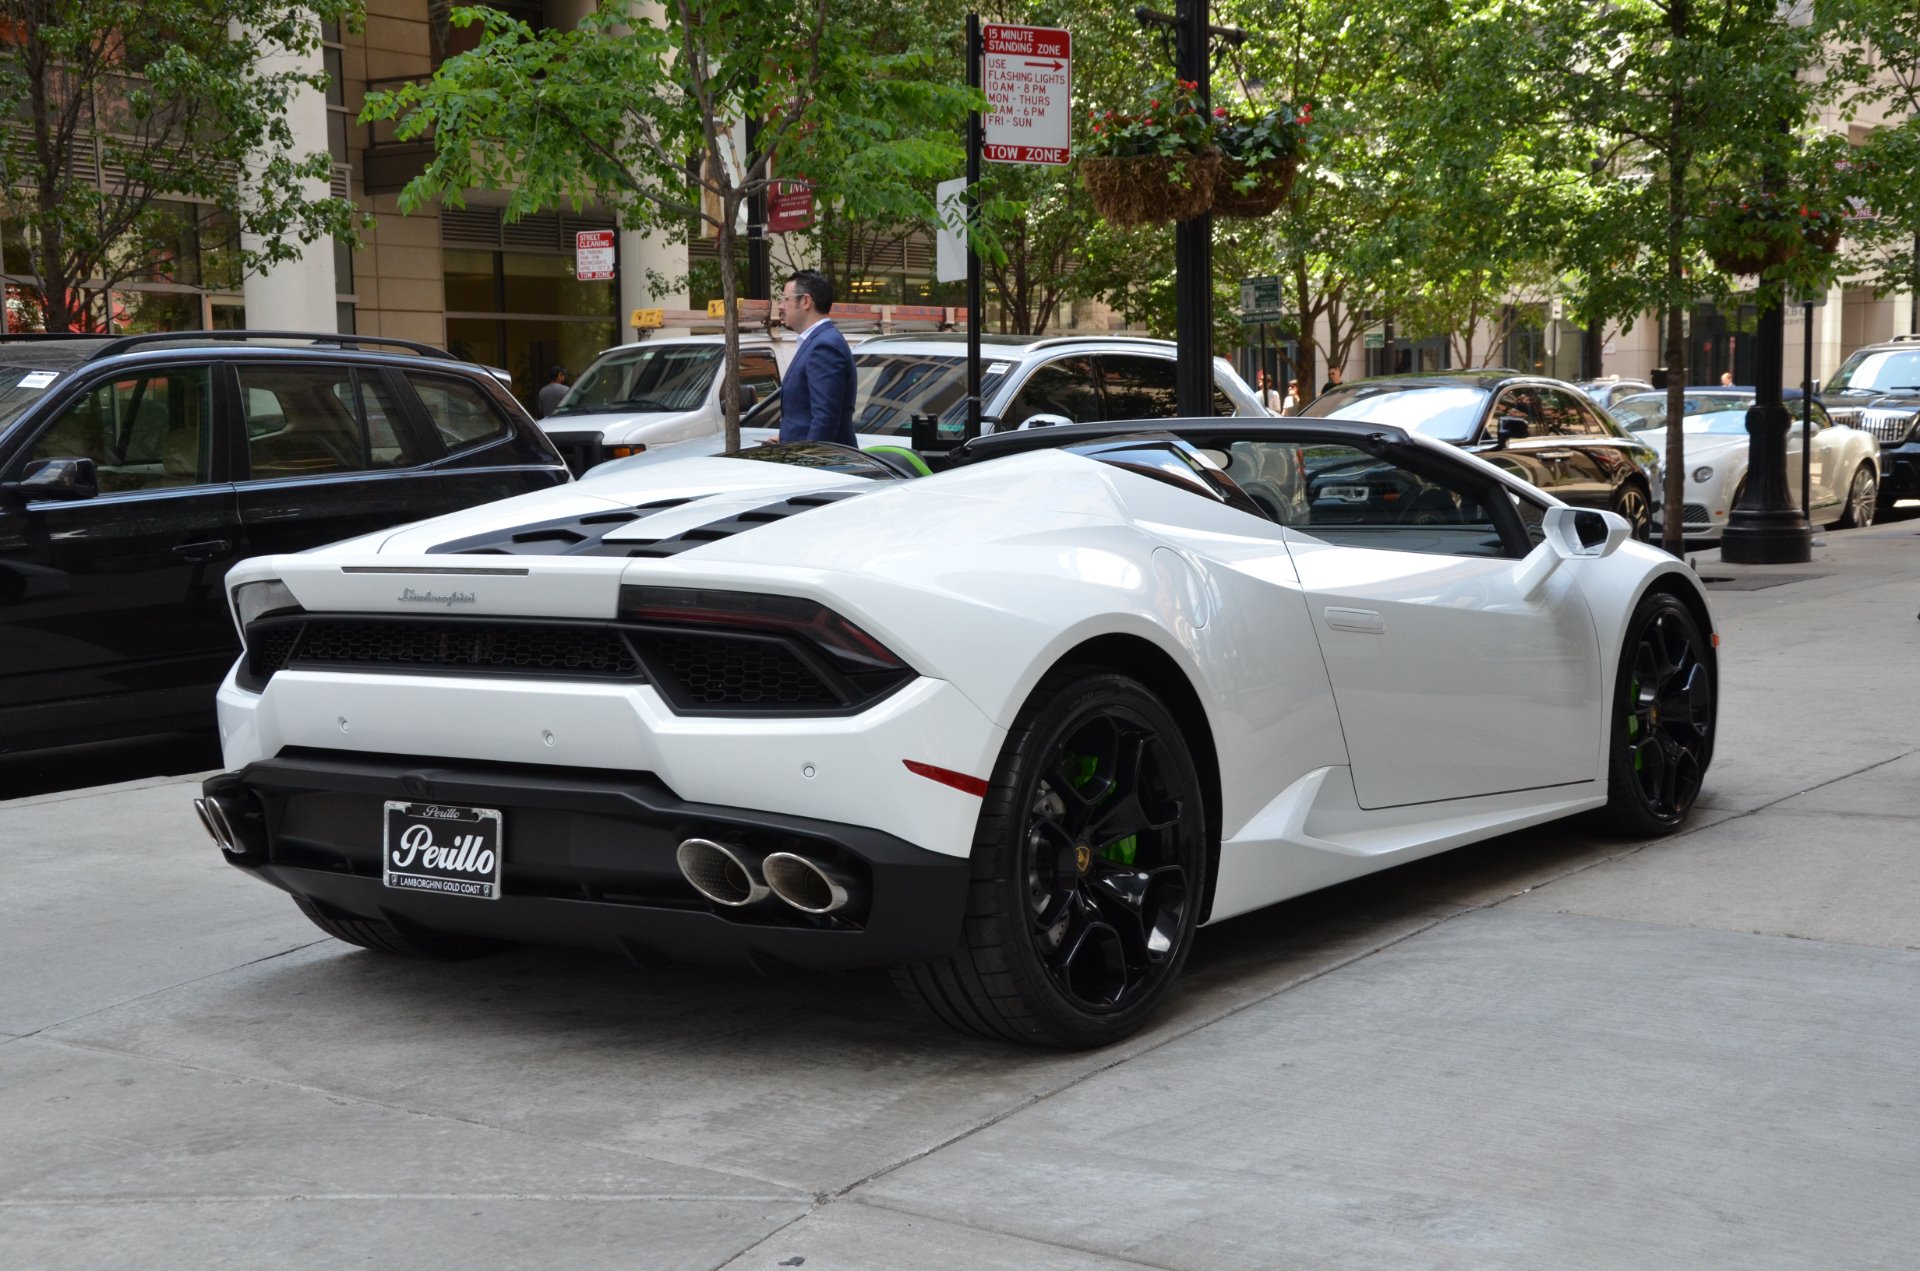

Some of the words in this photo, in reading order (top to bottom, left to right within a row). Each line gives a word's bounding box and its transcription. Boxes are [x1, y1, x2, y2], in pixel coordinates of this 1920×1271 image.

[988, 29, 998, 39] 15
[1001, 30, 1034, 41] MINUTE
[989, 40, 1032, 53] STANDING
[1038, 44, 1061, 55] ZONE
[989, 59, 1006, 69] USE
[989, 70, 1032, 82] FLASHING
[1035, 74, 1065, 85] LIGHTS
[989, 82, 998, 91] 10
[1001, 83, 1014, 92] AM
[1024, 85, 1029, 93] 8
[1033, 85, 1046, 94] PM
[989, 93, 1008, 103] MON
[1020, 95, 1050, 105] THURS
[1001, 106, 1013, 115] AM
[1024, 107, 1029, 115] 6
[1032, 108, 1044, 117] PM
[989, 116, 1003, 125] FRI
[1013, 118, 1032, 127] SUN
[989, 146, 1018, 160] TOW
[1026, 148, 1062, 162] ZONE
[423, 806, 460, 818] Perillo
[392, 824, 494, 874] Perillo
[400, 878, 442, 889] LAMBORGHINI
[443, 881, 460, 892] GOLD
[461, 884, 480, 894] COAST
